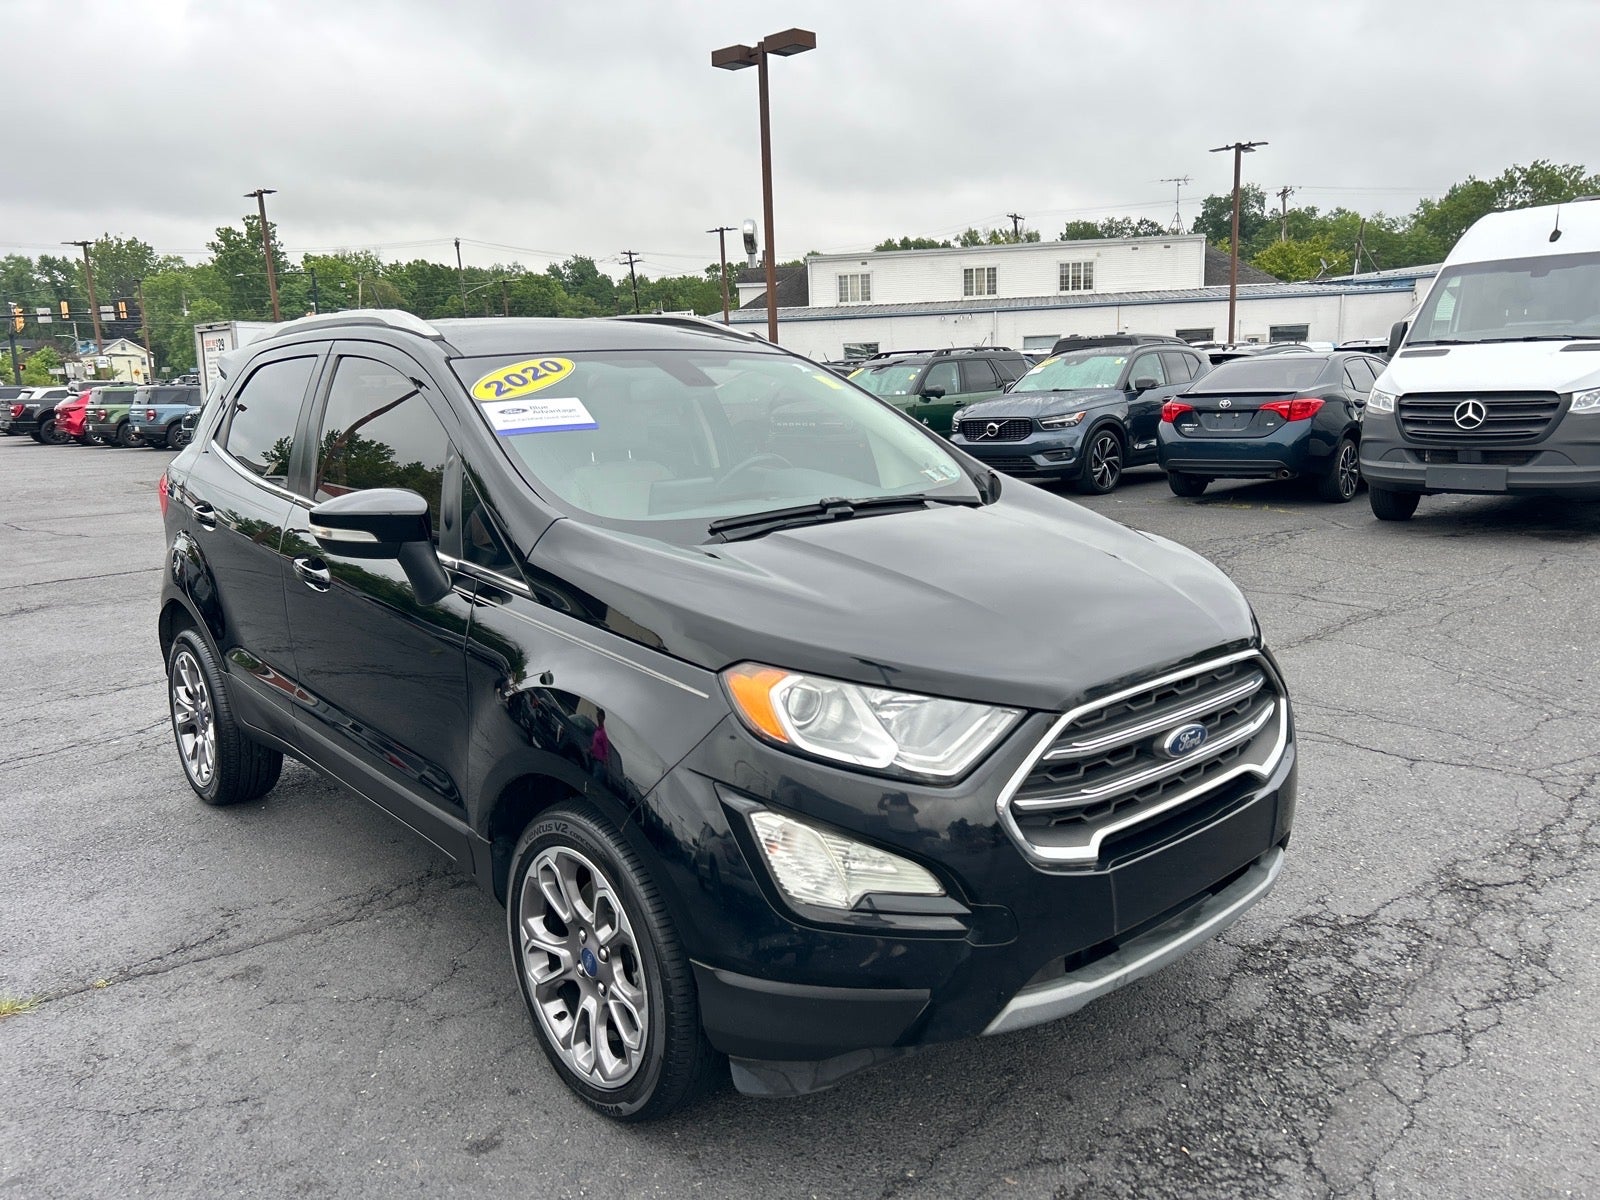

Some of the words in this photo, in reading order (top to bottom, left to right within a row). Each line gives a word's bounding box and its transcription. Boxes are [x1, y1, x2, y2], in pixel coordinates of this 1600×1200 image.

[484, 360, 565, 397] 2020
[1179, 730, 1201, 751] Ford
[554, 822, 569, 834] V2
